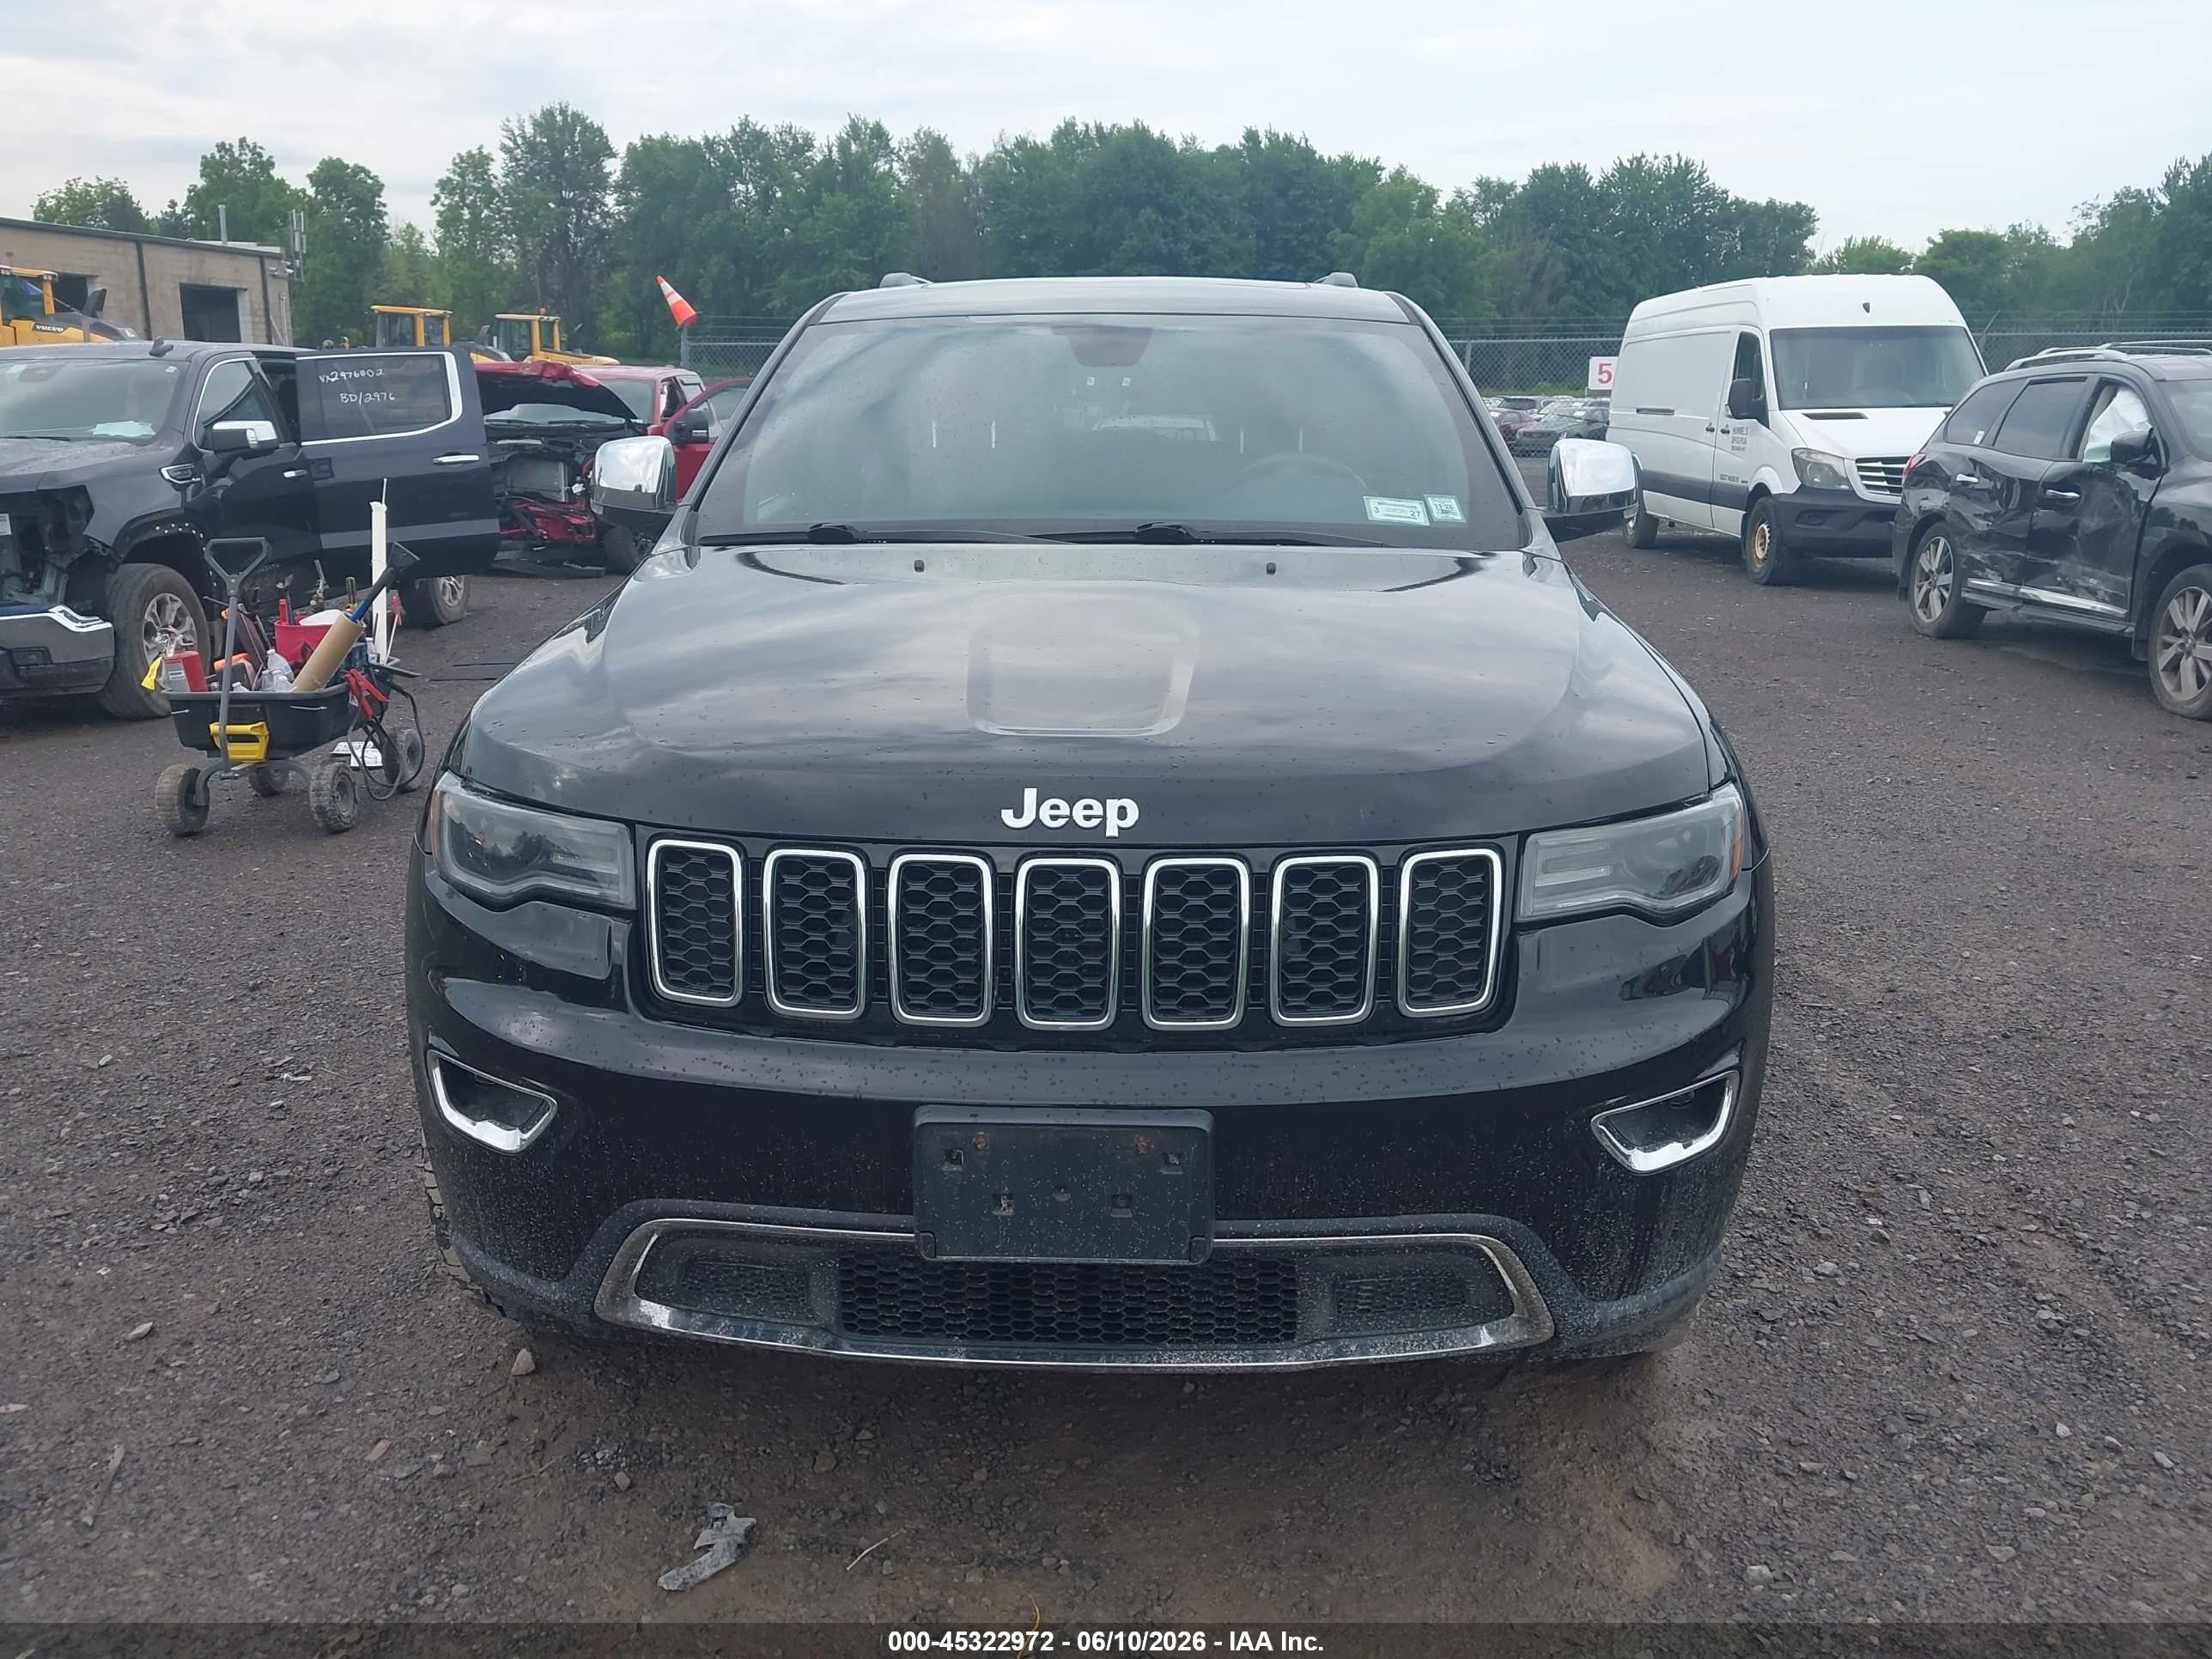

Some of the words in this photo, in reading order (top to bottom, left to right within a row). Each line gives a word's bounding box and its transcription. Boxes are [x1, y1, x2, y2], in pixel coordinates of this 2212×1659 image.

[1597, 362, 1613, 384] 5
[339, 392, 395, 405] BD/2976
[1001, 787, 1139, 838] Jeep
